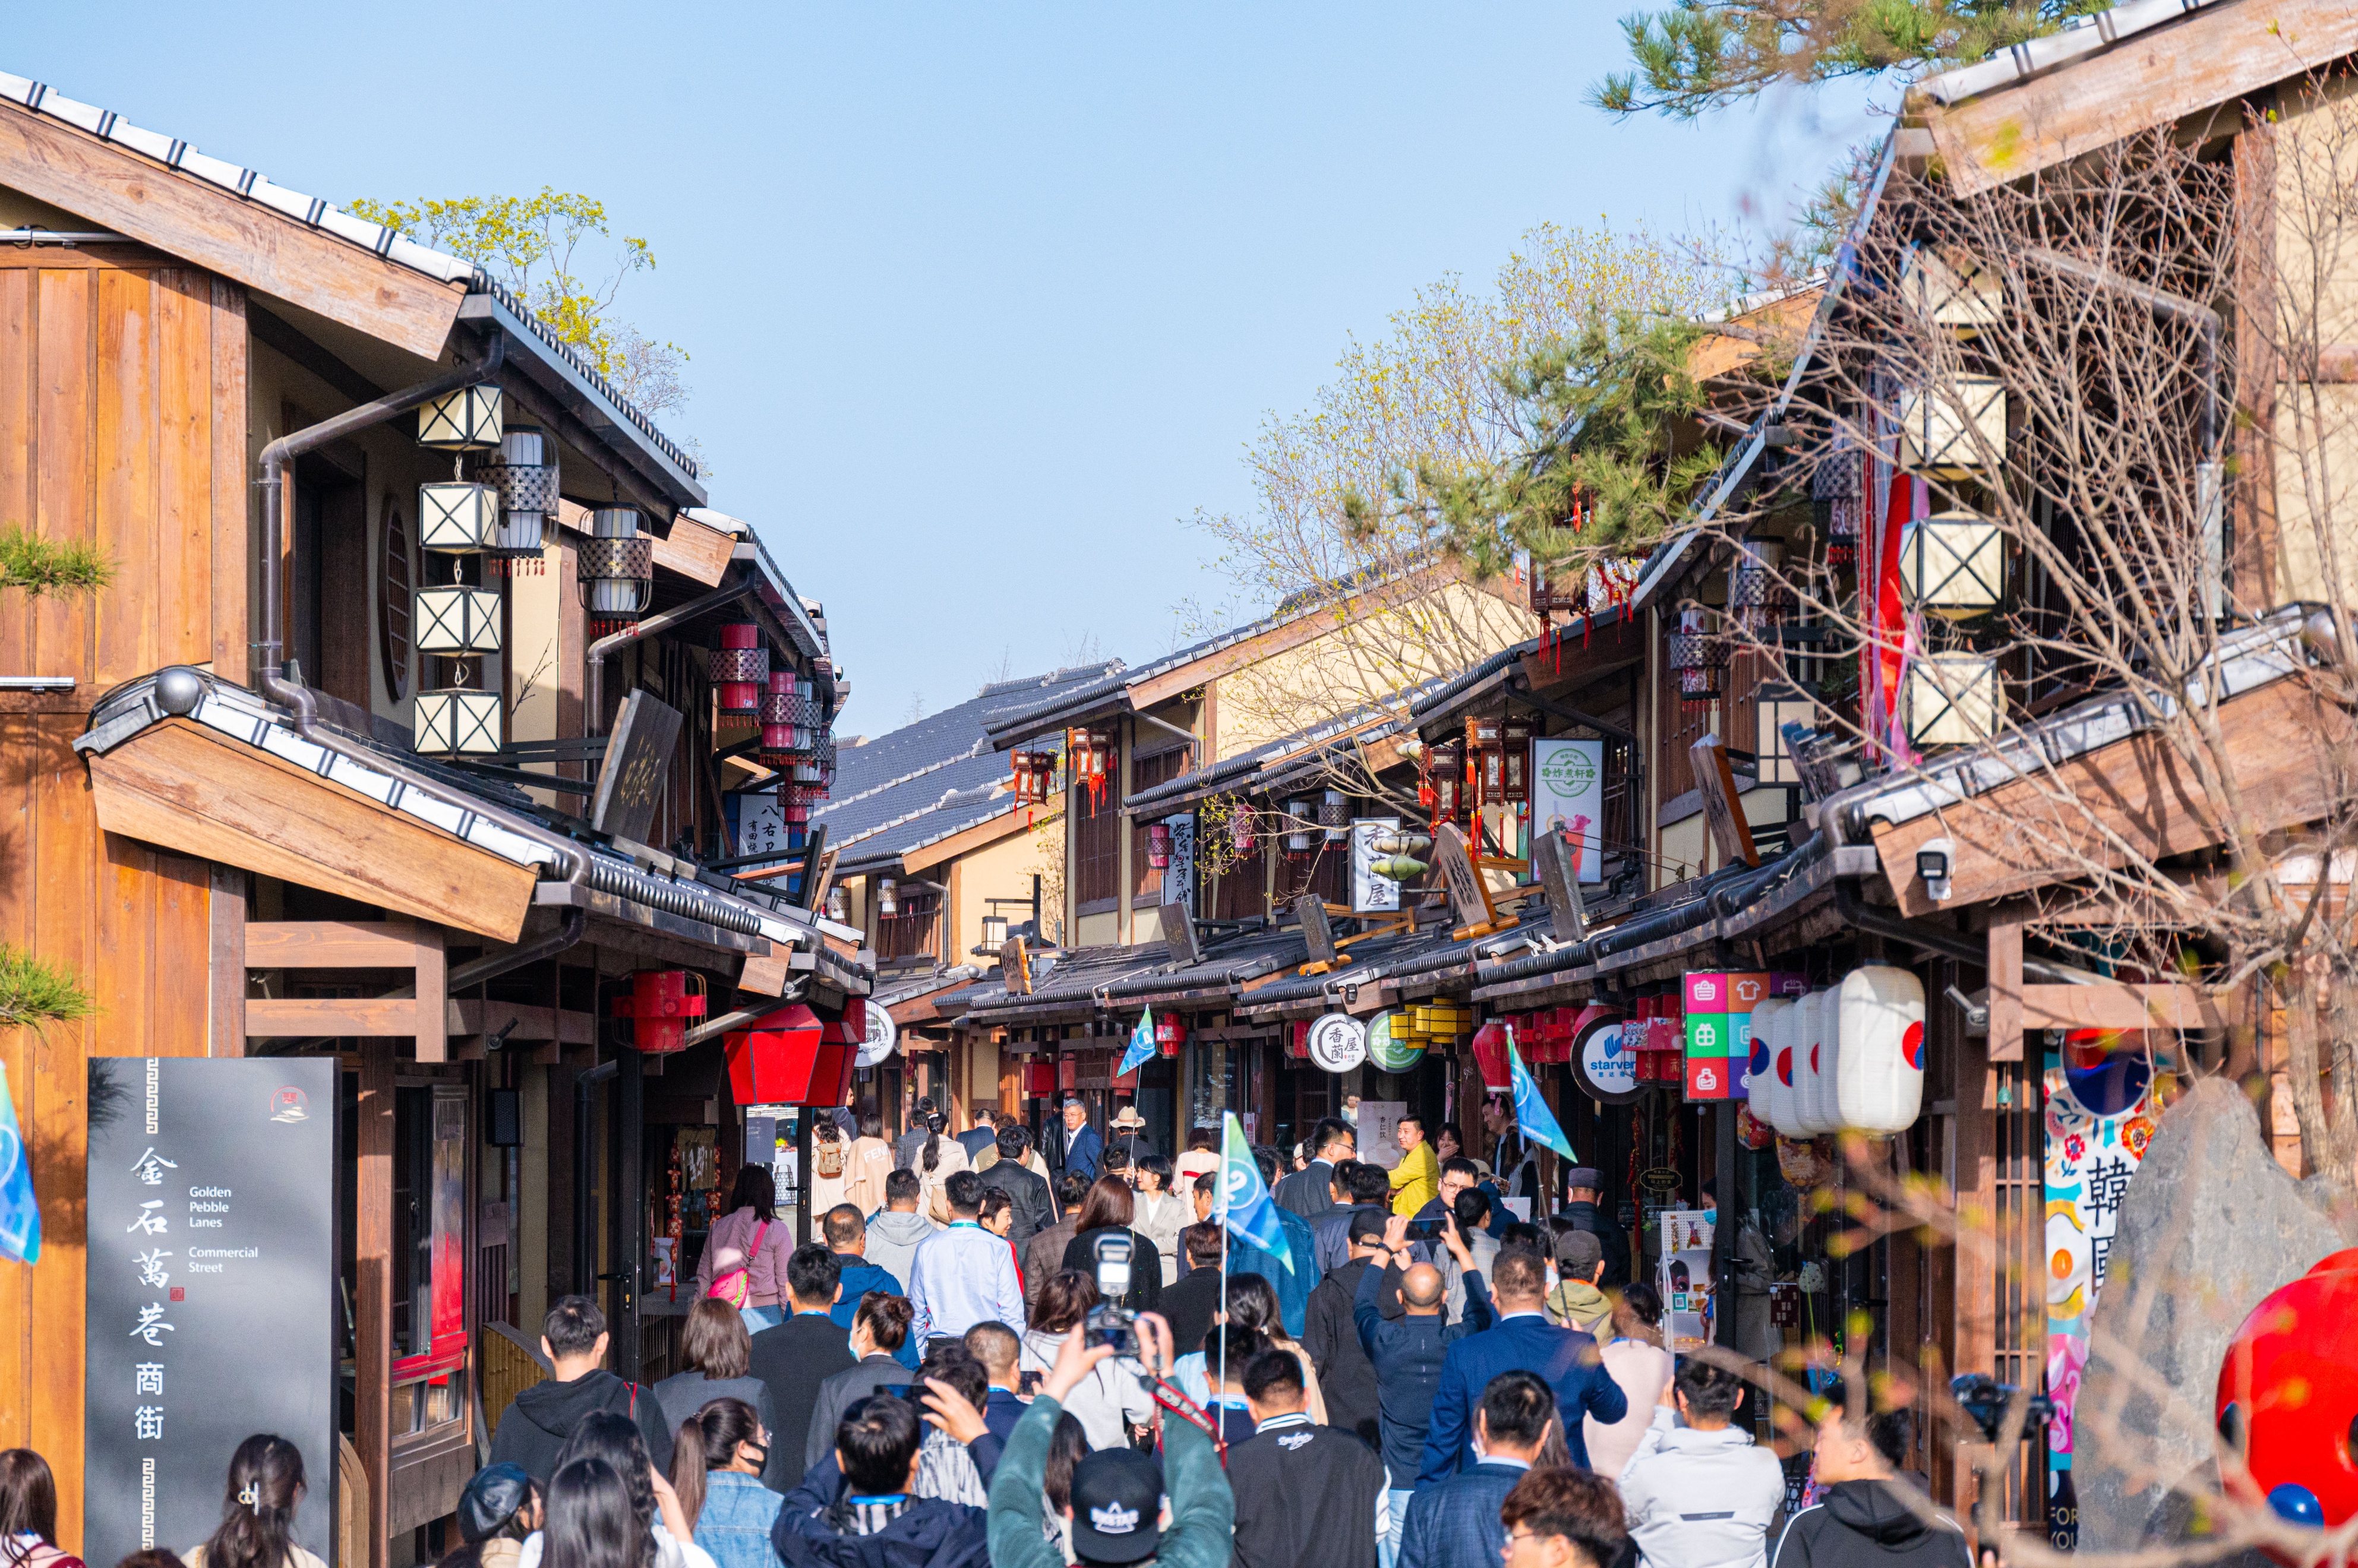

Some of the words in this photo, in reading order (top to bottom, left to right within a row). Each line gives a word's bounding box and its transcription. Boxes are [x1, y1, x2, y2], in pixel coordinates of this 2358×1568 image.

[1143, 1030, 1153, 1045] 4
[189, 1186, 232, 1197] Golden
[189, 1201, 229, 1213] Pebble
[189, 1217, 222, 1228] Lanes
[188, 1247, 258, 1258] Commercial
[188, 1262, 223, 1273] Street
[127, 1147, 178, 1440] 金石萬巷商街
